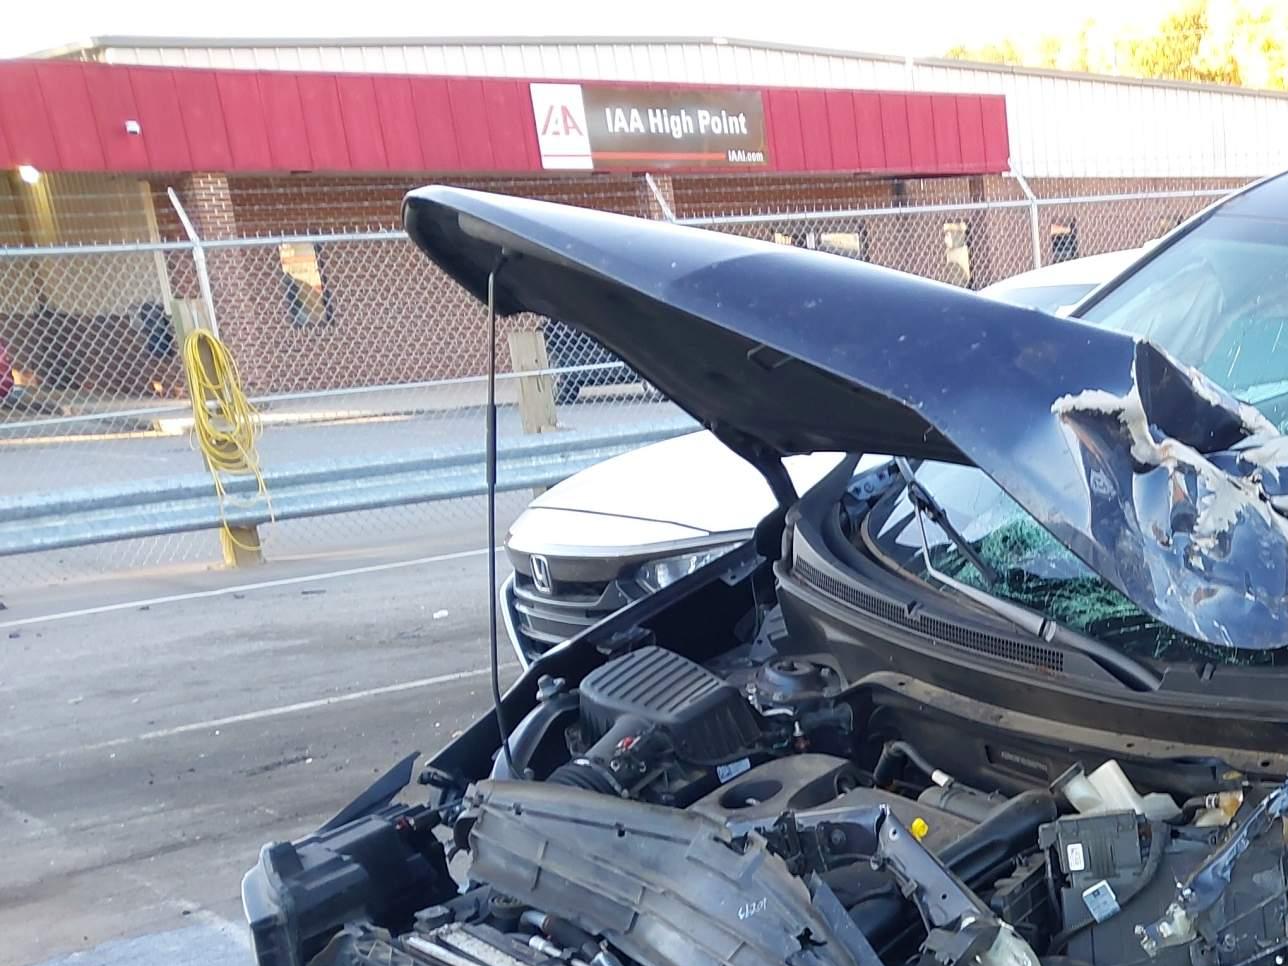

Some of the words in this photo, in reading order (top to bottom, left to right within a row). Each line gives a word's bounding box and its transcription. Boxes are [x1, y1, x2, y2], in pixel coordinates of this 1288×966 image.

[605, 108, 645, 133] IAA
[648, 108, 694, 139] High
[698, 109, 748, 135] Point
